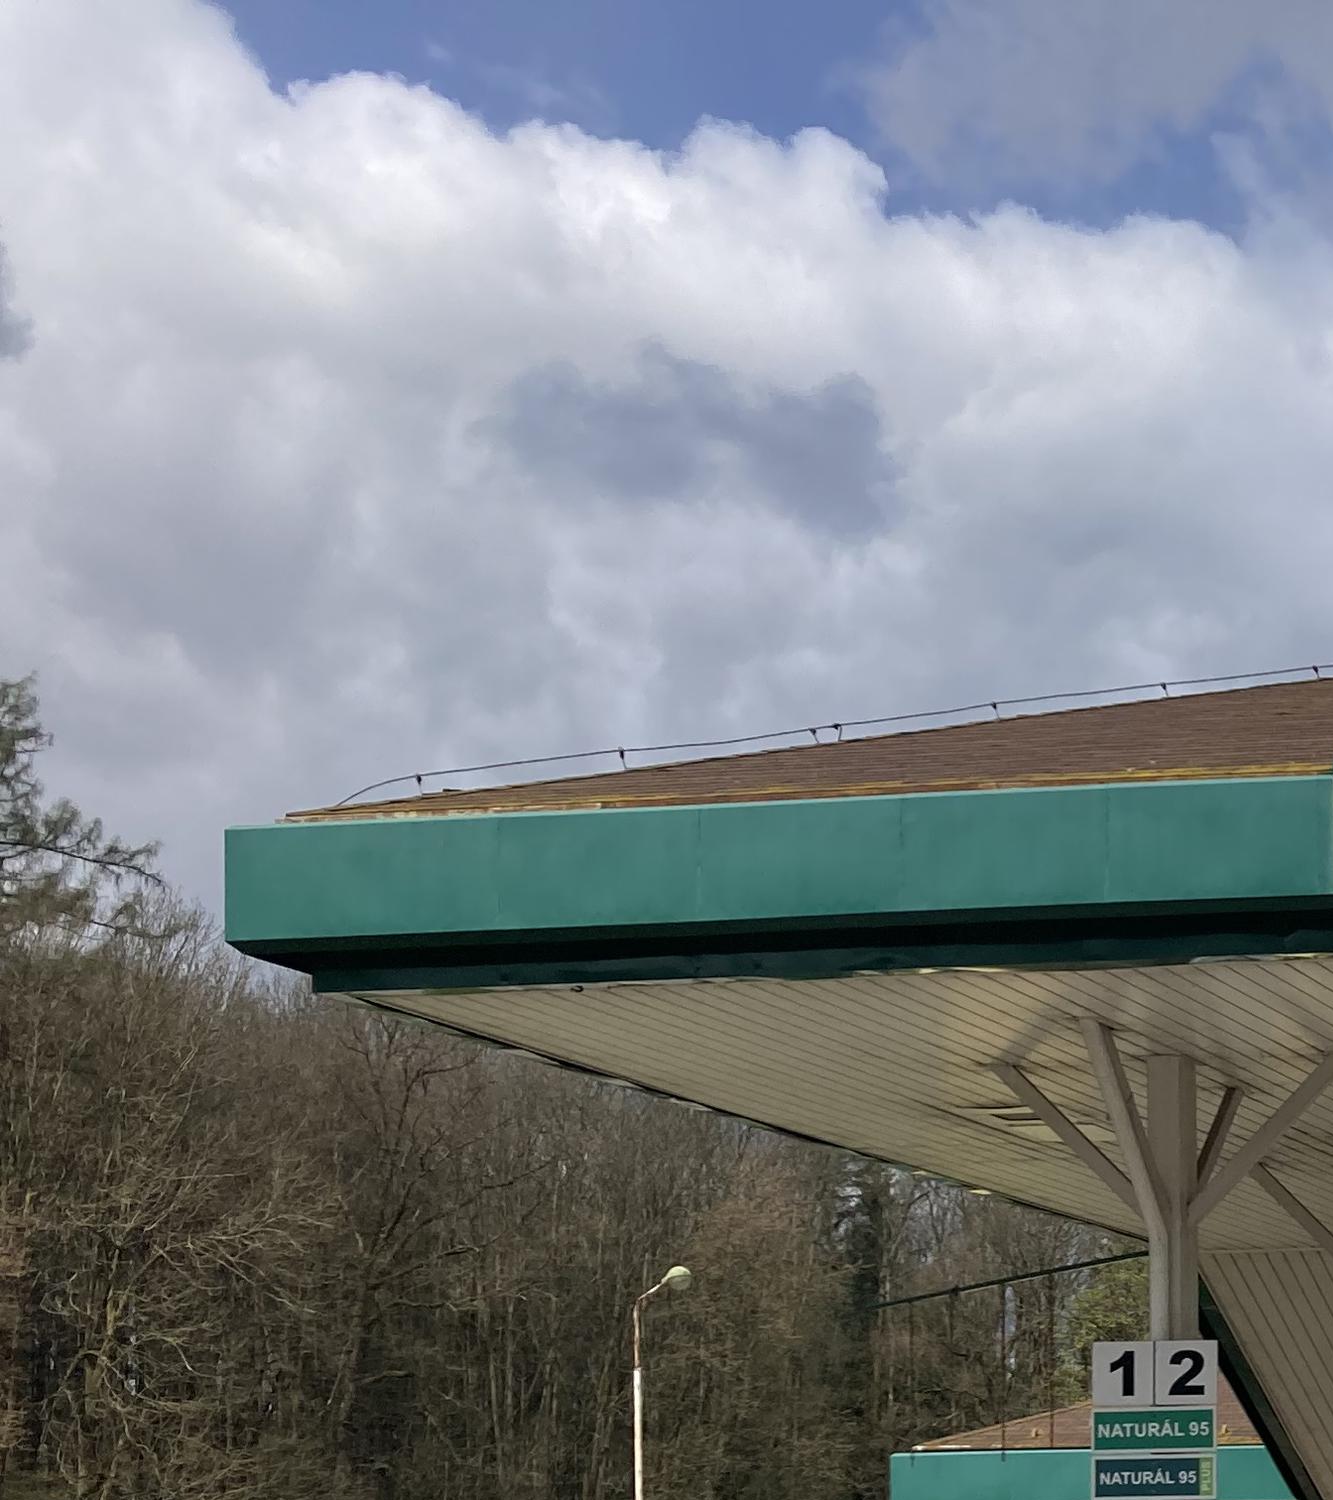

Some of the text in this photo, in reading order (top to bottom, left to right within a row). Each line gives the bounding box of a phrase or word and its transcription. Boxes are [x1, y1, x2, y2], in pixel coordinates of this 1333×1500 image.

[1109, 1350, 1205, 1396] 1 2
[1097, 1419, 1209, 1437] NATURÁL 95
[1100, 1461, 1211, 1491] NATURÁL 95 PLUS
